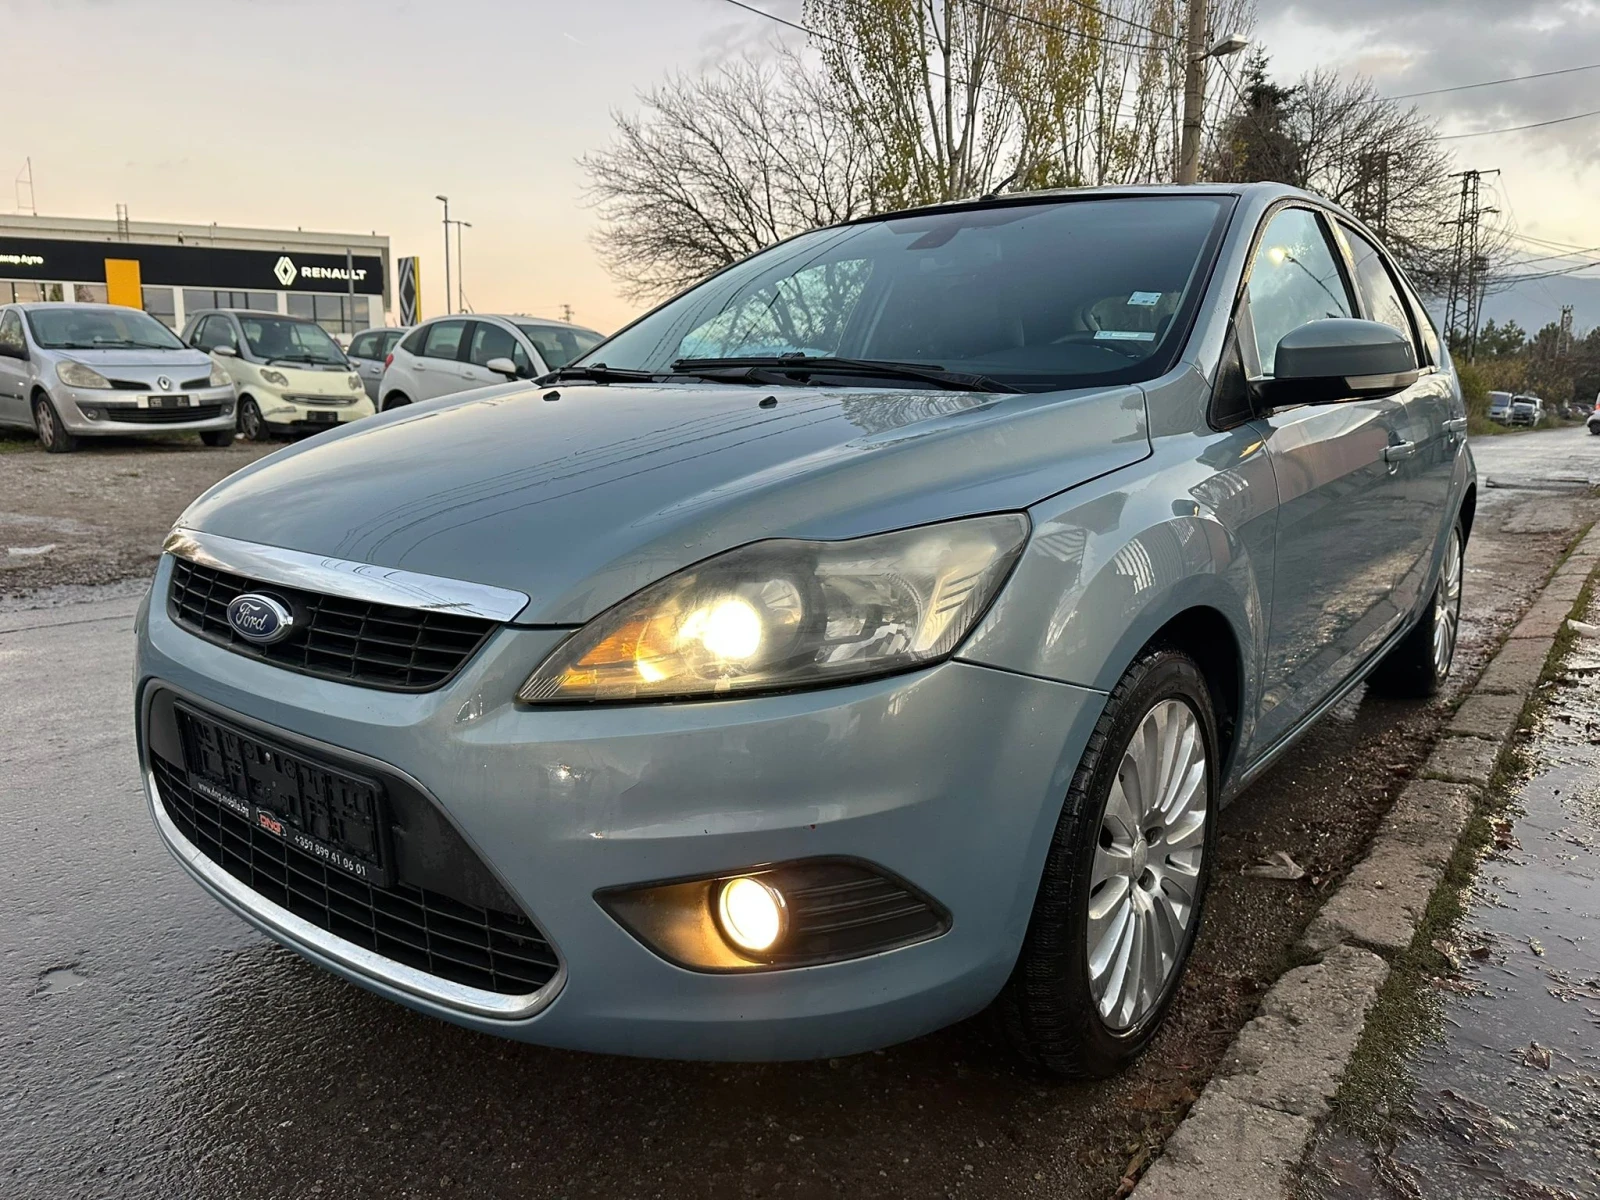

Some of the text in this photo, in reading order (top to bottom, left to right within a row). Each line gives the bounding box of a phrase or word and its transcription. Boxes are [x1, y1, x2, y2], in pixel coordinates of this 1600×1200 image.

[301, 266, 367, 280] RENAULT
[235, 602, 268, 631] Ford
[294, 835, 366, 876] +359 899 41 06 01
